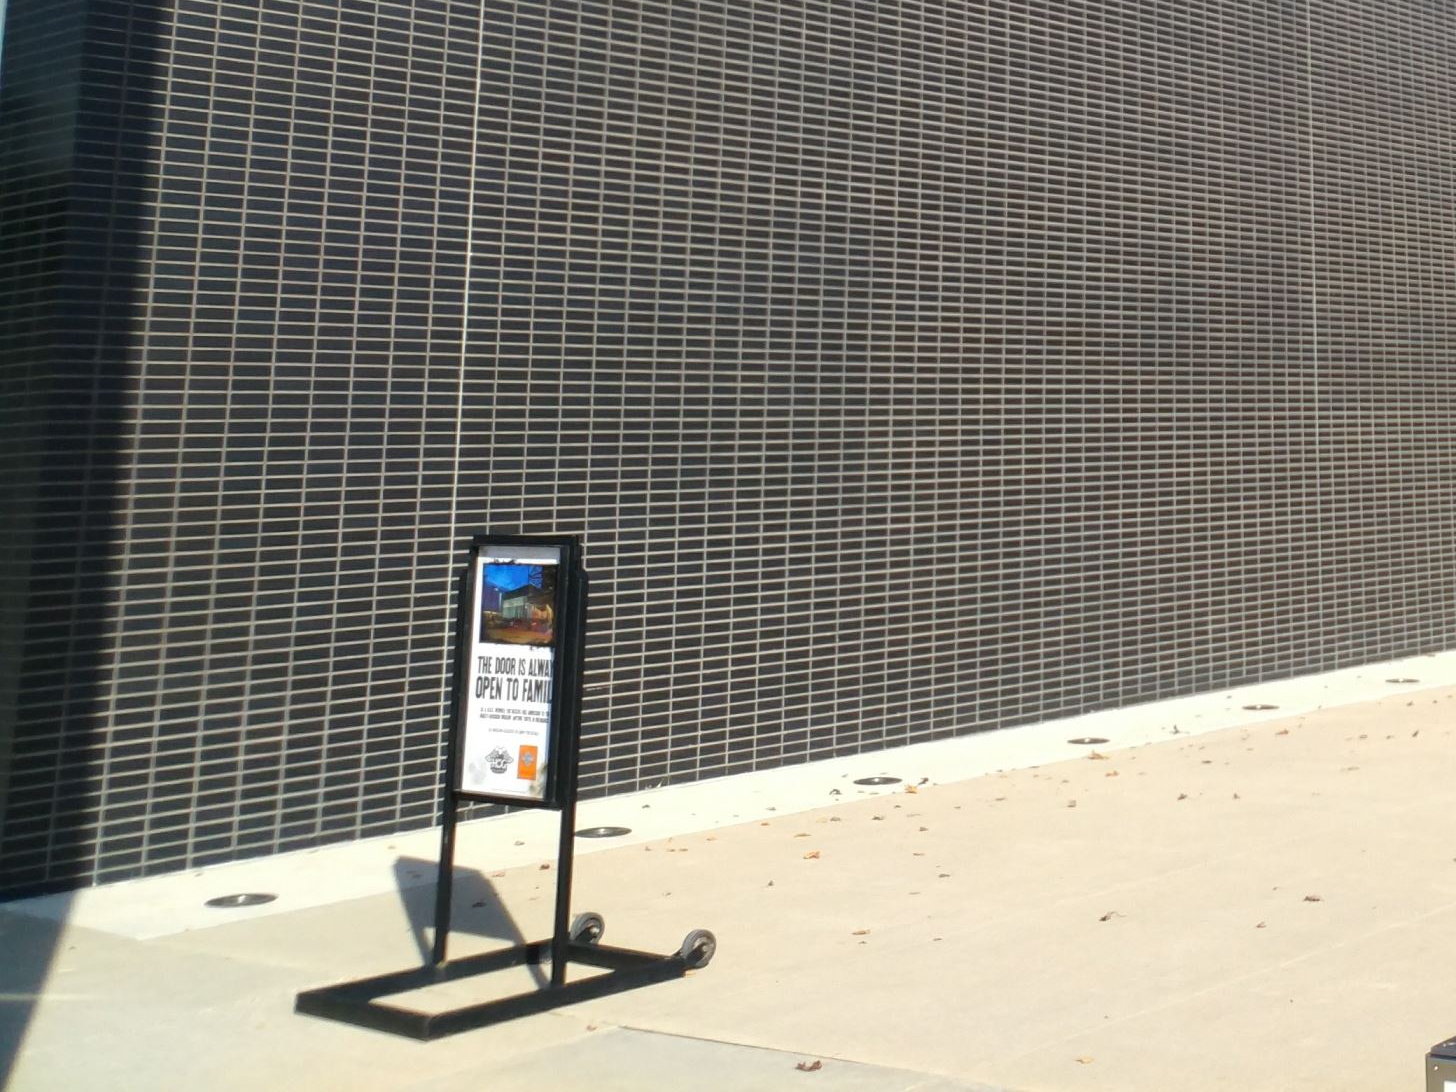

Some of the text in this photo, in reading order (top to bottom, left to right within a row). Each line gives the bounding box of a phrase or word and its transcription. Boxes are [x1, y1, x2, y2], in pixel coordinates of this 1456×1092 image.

[477, 656, 493, 674] THE
[495, 657, 516, 675] DOOR
[518, 658, 526, 676] IS
[475, 676, 503, 700] OPEN
[506, 677, 519, 701] TO
